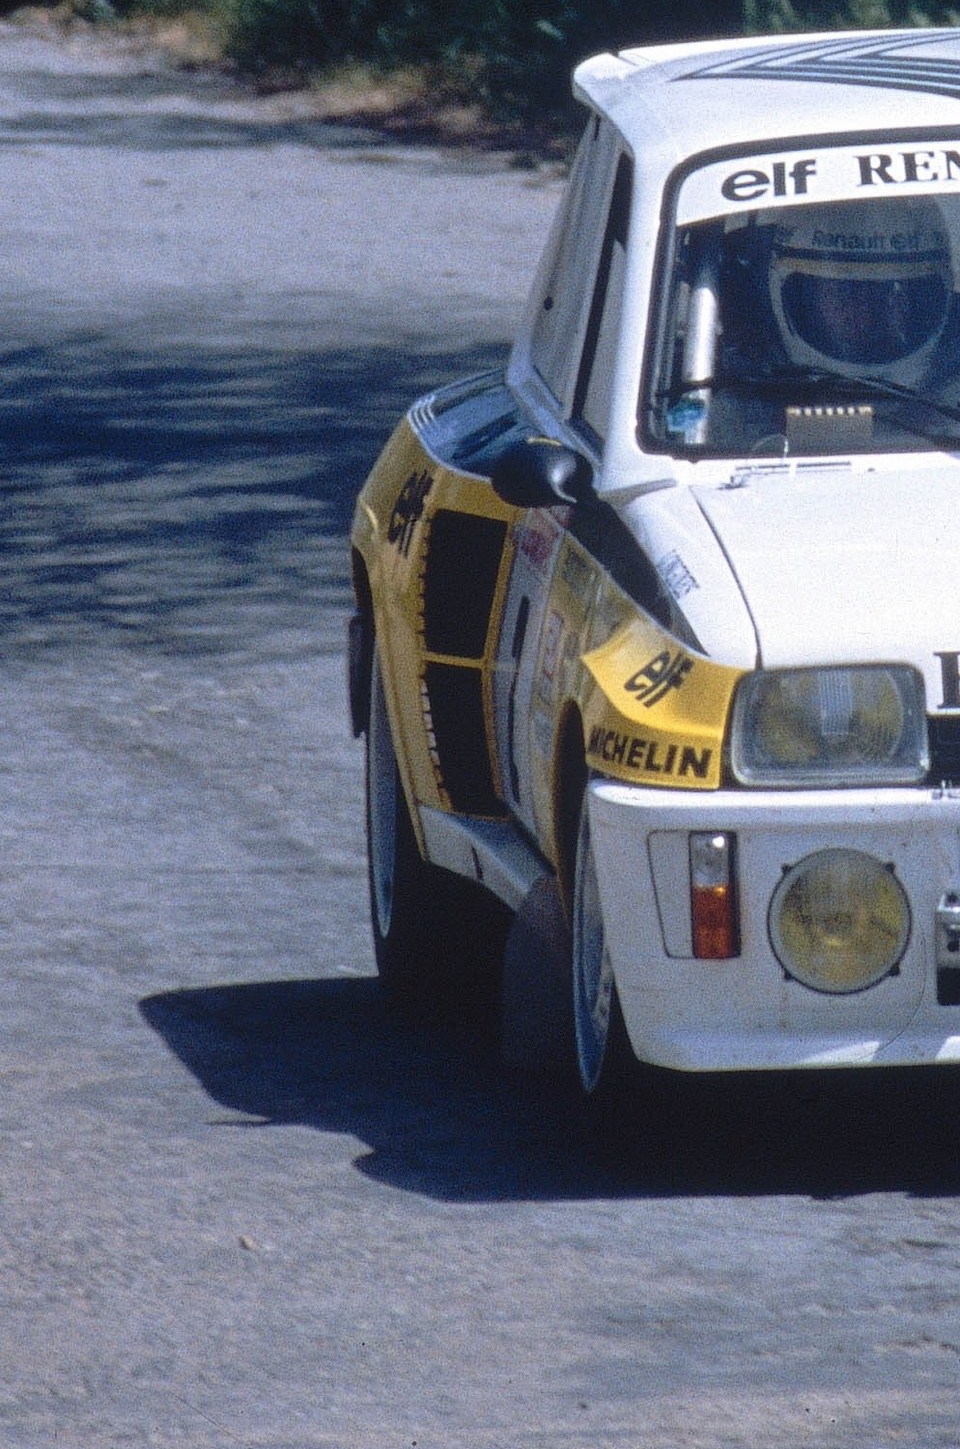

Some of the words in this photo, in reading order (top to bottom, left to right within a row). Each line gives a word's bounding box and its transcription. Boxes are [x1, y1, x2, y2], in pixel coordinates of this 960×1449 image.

[720, 158, 818, 202] elf
[623, 650, 695, 709] elf
[587, 724, 713, 779] MICHELIN
